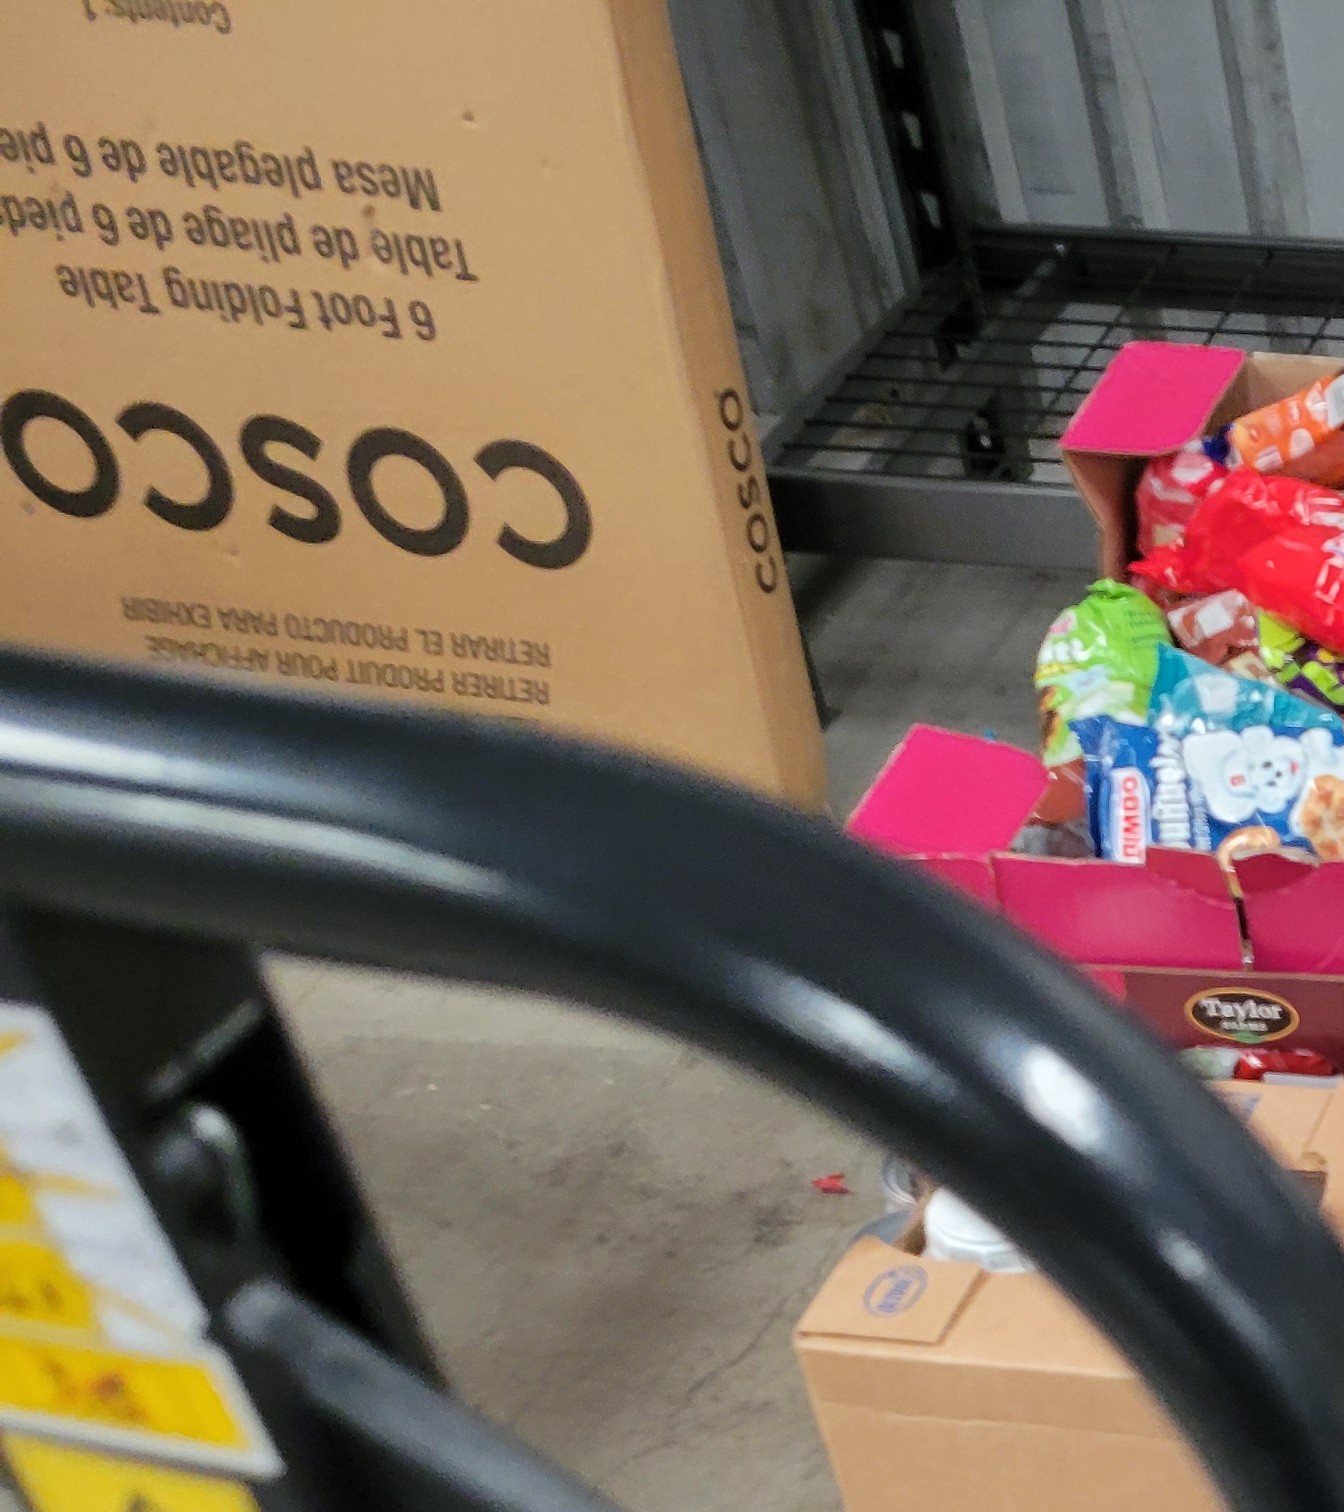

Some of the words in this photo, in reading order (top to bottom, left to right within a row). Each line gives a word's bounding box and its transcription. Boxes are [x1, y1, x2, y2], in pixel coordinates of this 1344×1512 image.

[64, 133, 92, 177] 6
[98, 136, 148, 182] de
[156, 139, 322, 198] plegable
[332, 158, 442, 211] Mesa
[0, 191, 84, 241] pied
[92, 202, 119, 246] 6
[126, 205, 173, 250] de
[182, 203, 302, 263] pliage
[312, 223, 359, 270] de
[371, 226, 479, 282] Table
[55, 263, 161, 315] Table
[162, 265, 308, 331] Folding
[311, 289, 402, 339] Foot
[408, 299, 436, 341] 6
[0, 388, 593, 570] COSCO
[717, 388, 778, 594] COSCO
[121, 595, 211, 629] EXHIBIR
[217, 605, 279, 637] PARA
[286, 613, 410, 652] PRODUCTO
[414, 627, 444, 656] EL
[451, 631, 551, 667] RETIRAR
[275, 650, 338, 681] POUR
[346, 663, 445, 694] PRODUIT
[452, 670, 550, 705] RETIRER
[1200, 997, 1283, 1024] Taylor
